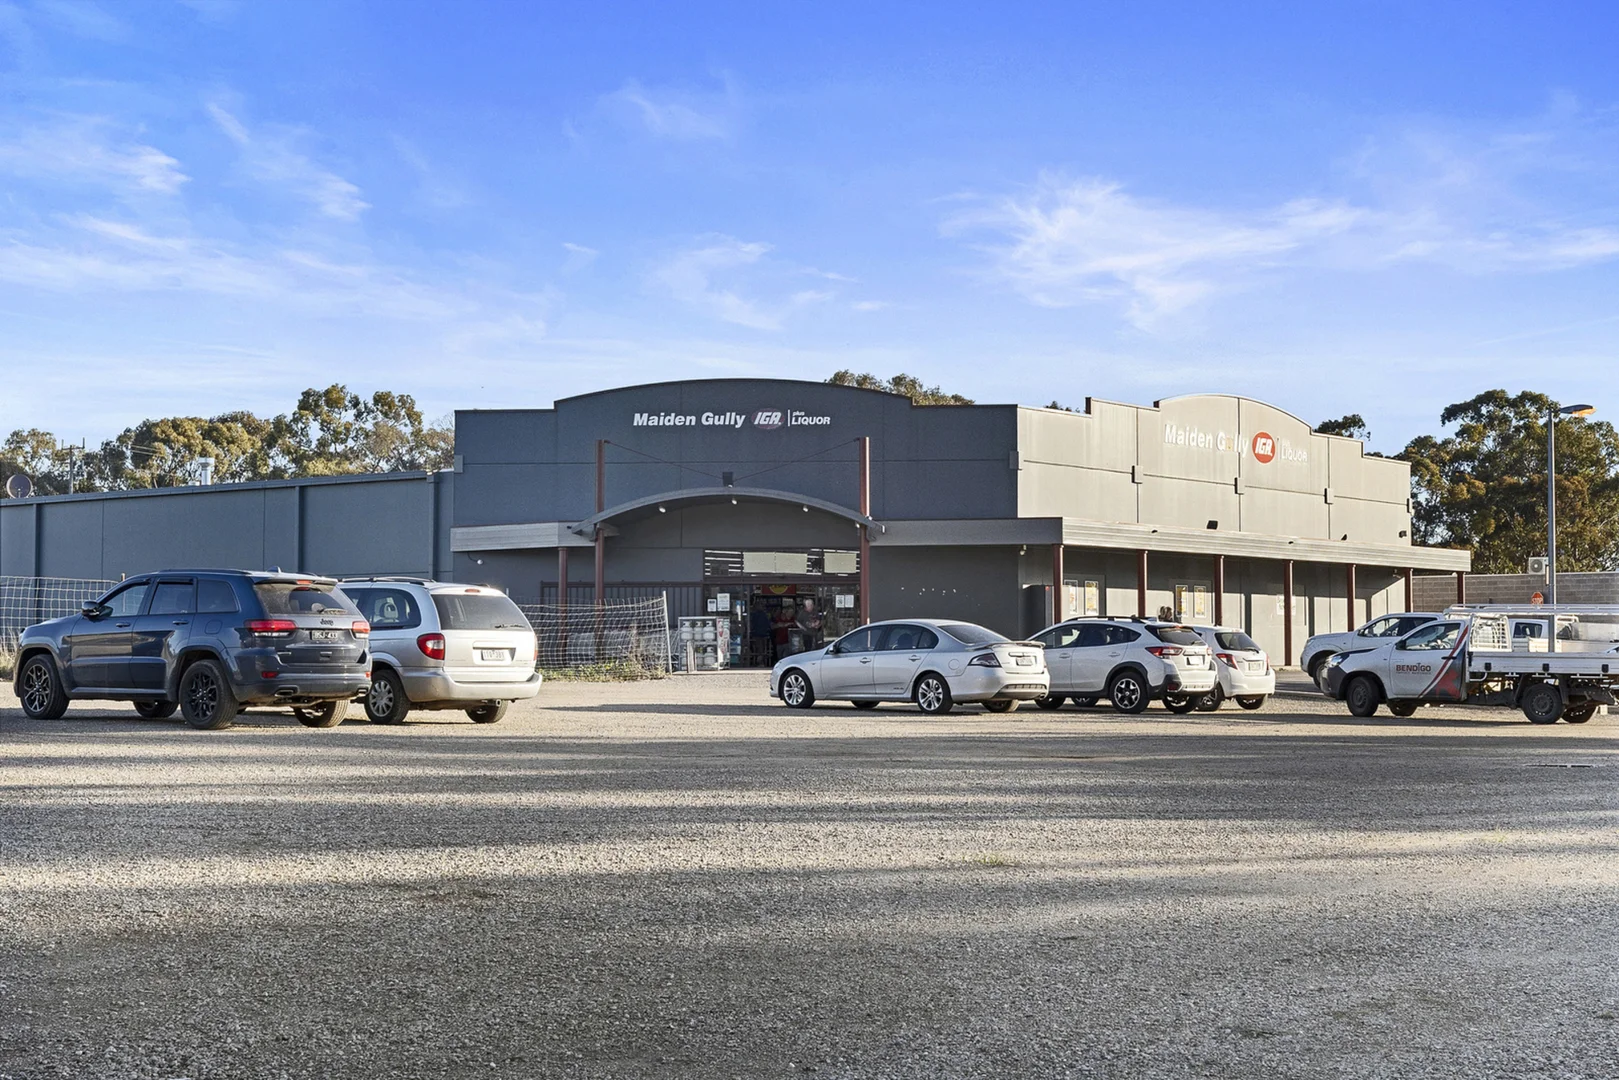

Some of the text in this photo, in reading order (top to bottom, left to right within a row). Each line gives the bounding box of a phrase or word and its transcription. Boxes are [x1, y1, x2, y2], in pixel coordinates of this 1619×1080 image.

[633, 411, 780, 428] Maiden Gully IGA
[791, 416, 831, 425] LIQUOR
[1165, 423, 1272, 458] Maiden Glly IGA
[1281, 446, 1308, 462] LIQUOR
[320, 618, 334, 626] Jeep
[1396, 662, 1432, 672] BENDIGO
